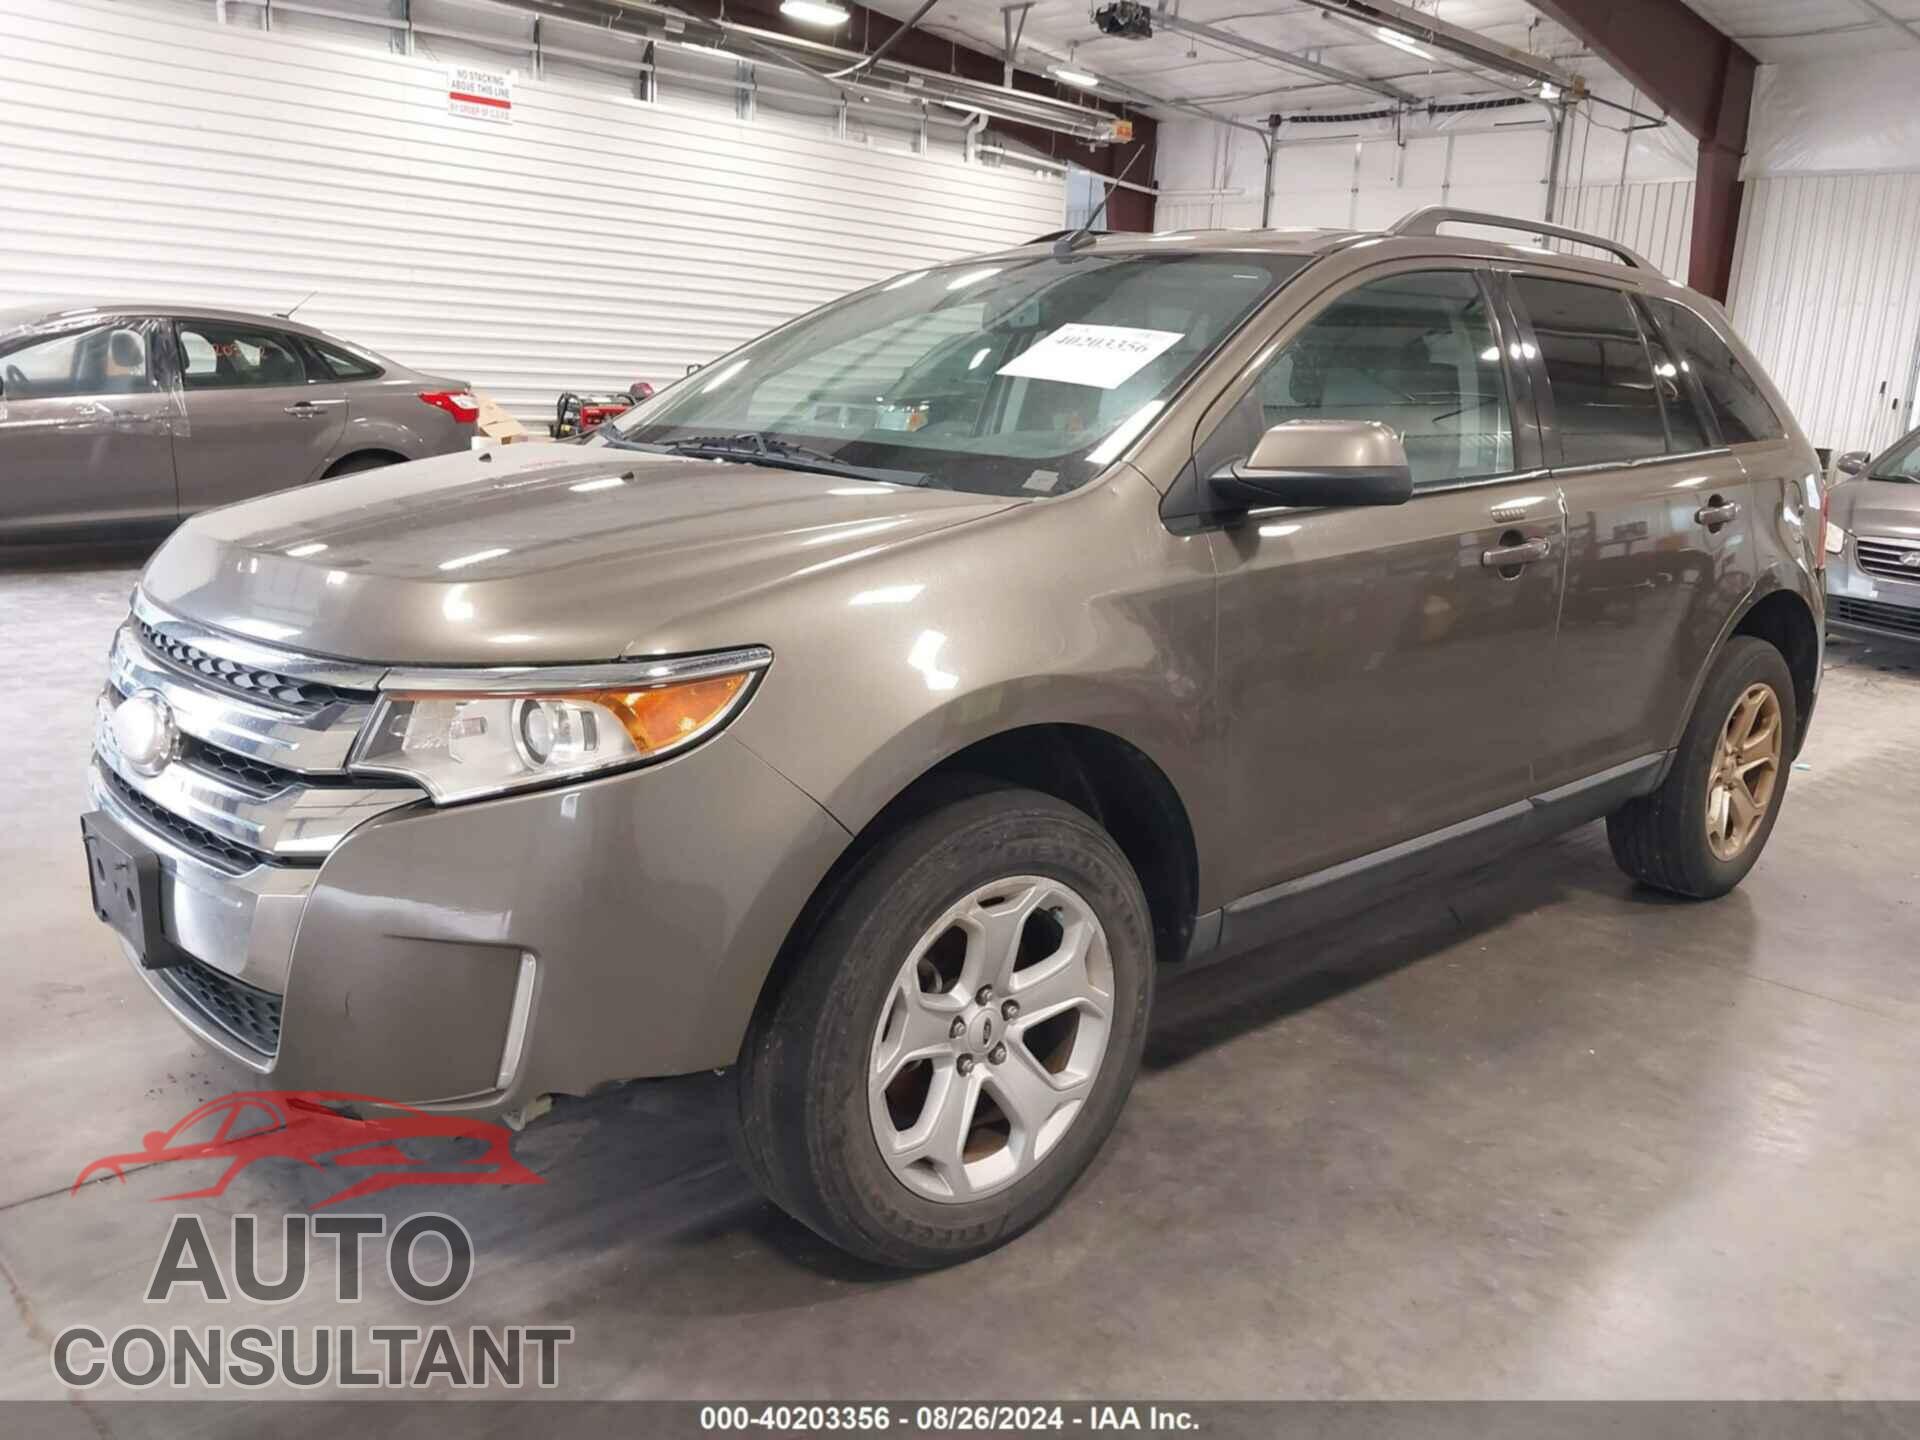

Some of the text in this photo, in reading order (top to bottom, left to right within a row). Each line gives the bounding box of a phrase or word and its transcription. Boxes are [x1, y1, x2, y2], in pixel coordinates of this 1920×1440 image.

[456, 69, 504, 86] NO STACKING
[451, 79, 511, 99] ABOVE THIS LINE
